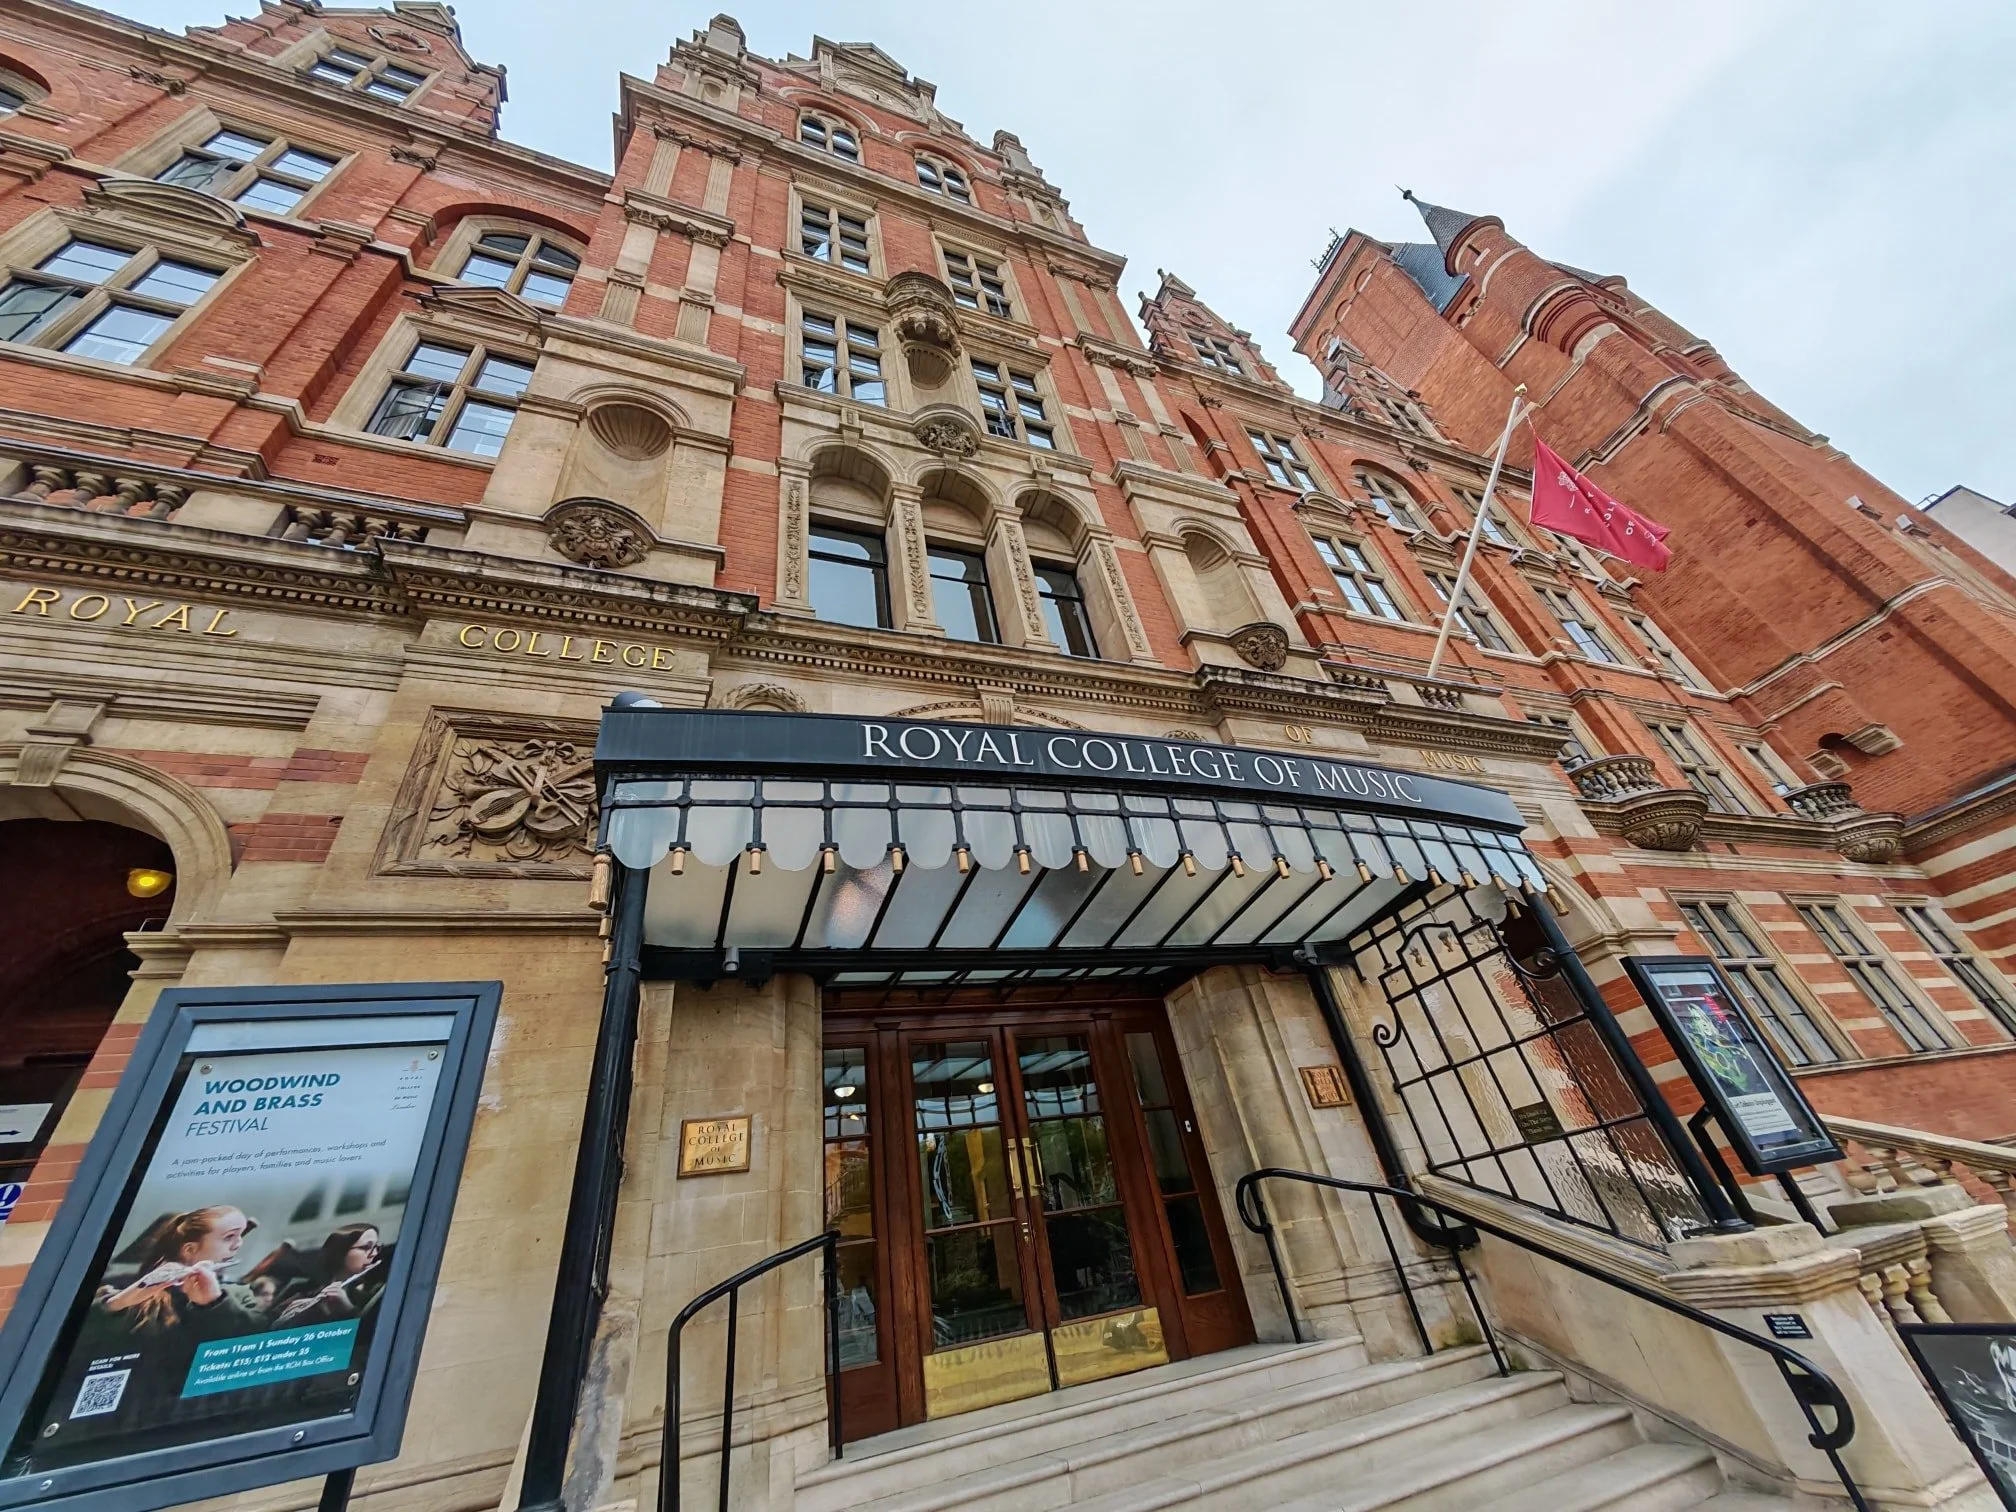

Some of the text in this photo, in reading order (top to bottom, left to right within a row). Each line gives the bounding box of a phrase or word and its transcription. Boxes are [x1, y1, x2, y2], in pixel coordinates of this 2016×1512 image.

[11, 587, 1487, 772] ROYAL COLLEGE OF MUSIC
[861, 724, 1422, 802] ROYAL COLLEGE OF MUSIC
[205, 1073, 341, 1095] WOODWIND
[193, 1093, 324, 1115] AND BRASS
[185, 1117, 269, 1137] FESTIVAL
[698, 1123, 738, 1134] ROYAL
[235, 1152, 253, 1160] day
[254, 1150, 264, 1158] of
[327, 1141, 368, 1150] workshops
[371, 1139, 386, 1147] and
[689, 1133, 744, 1145] COLLEGE
[166, 1170, 205, 1179] activities
[208, 1166, 221, 1175] for
[222, 1165, 257, 1175] players,
[260, 1160, 292, 1169] families
[295, 1158, 312, 1167] and
[313, 1157, 337, 1165] music
[694, 1154, 736, 1168] MUSIC
[204, 1347, 228, 1358] From
[231, 1343, 256, 1353] 11am
[267, 1336, 301, 1348] Sunday
[302, 1334, 315, 1342] 26
[317, 1328, 352, 1339] October
[272, 1351, 296, 1361] under
